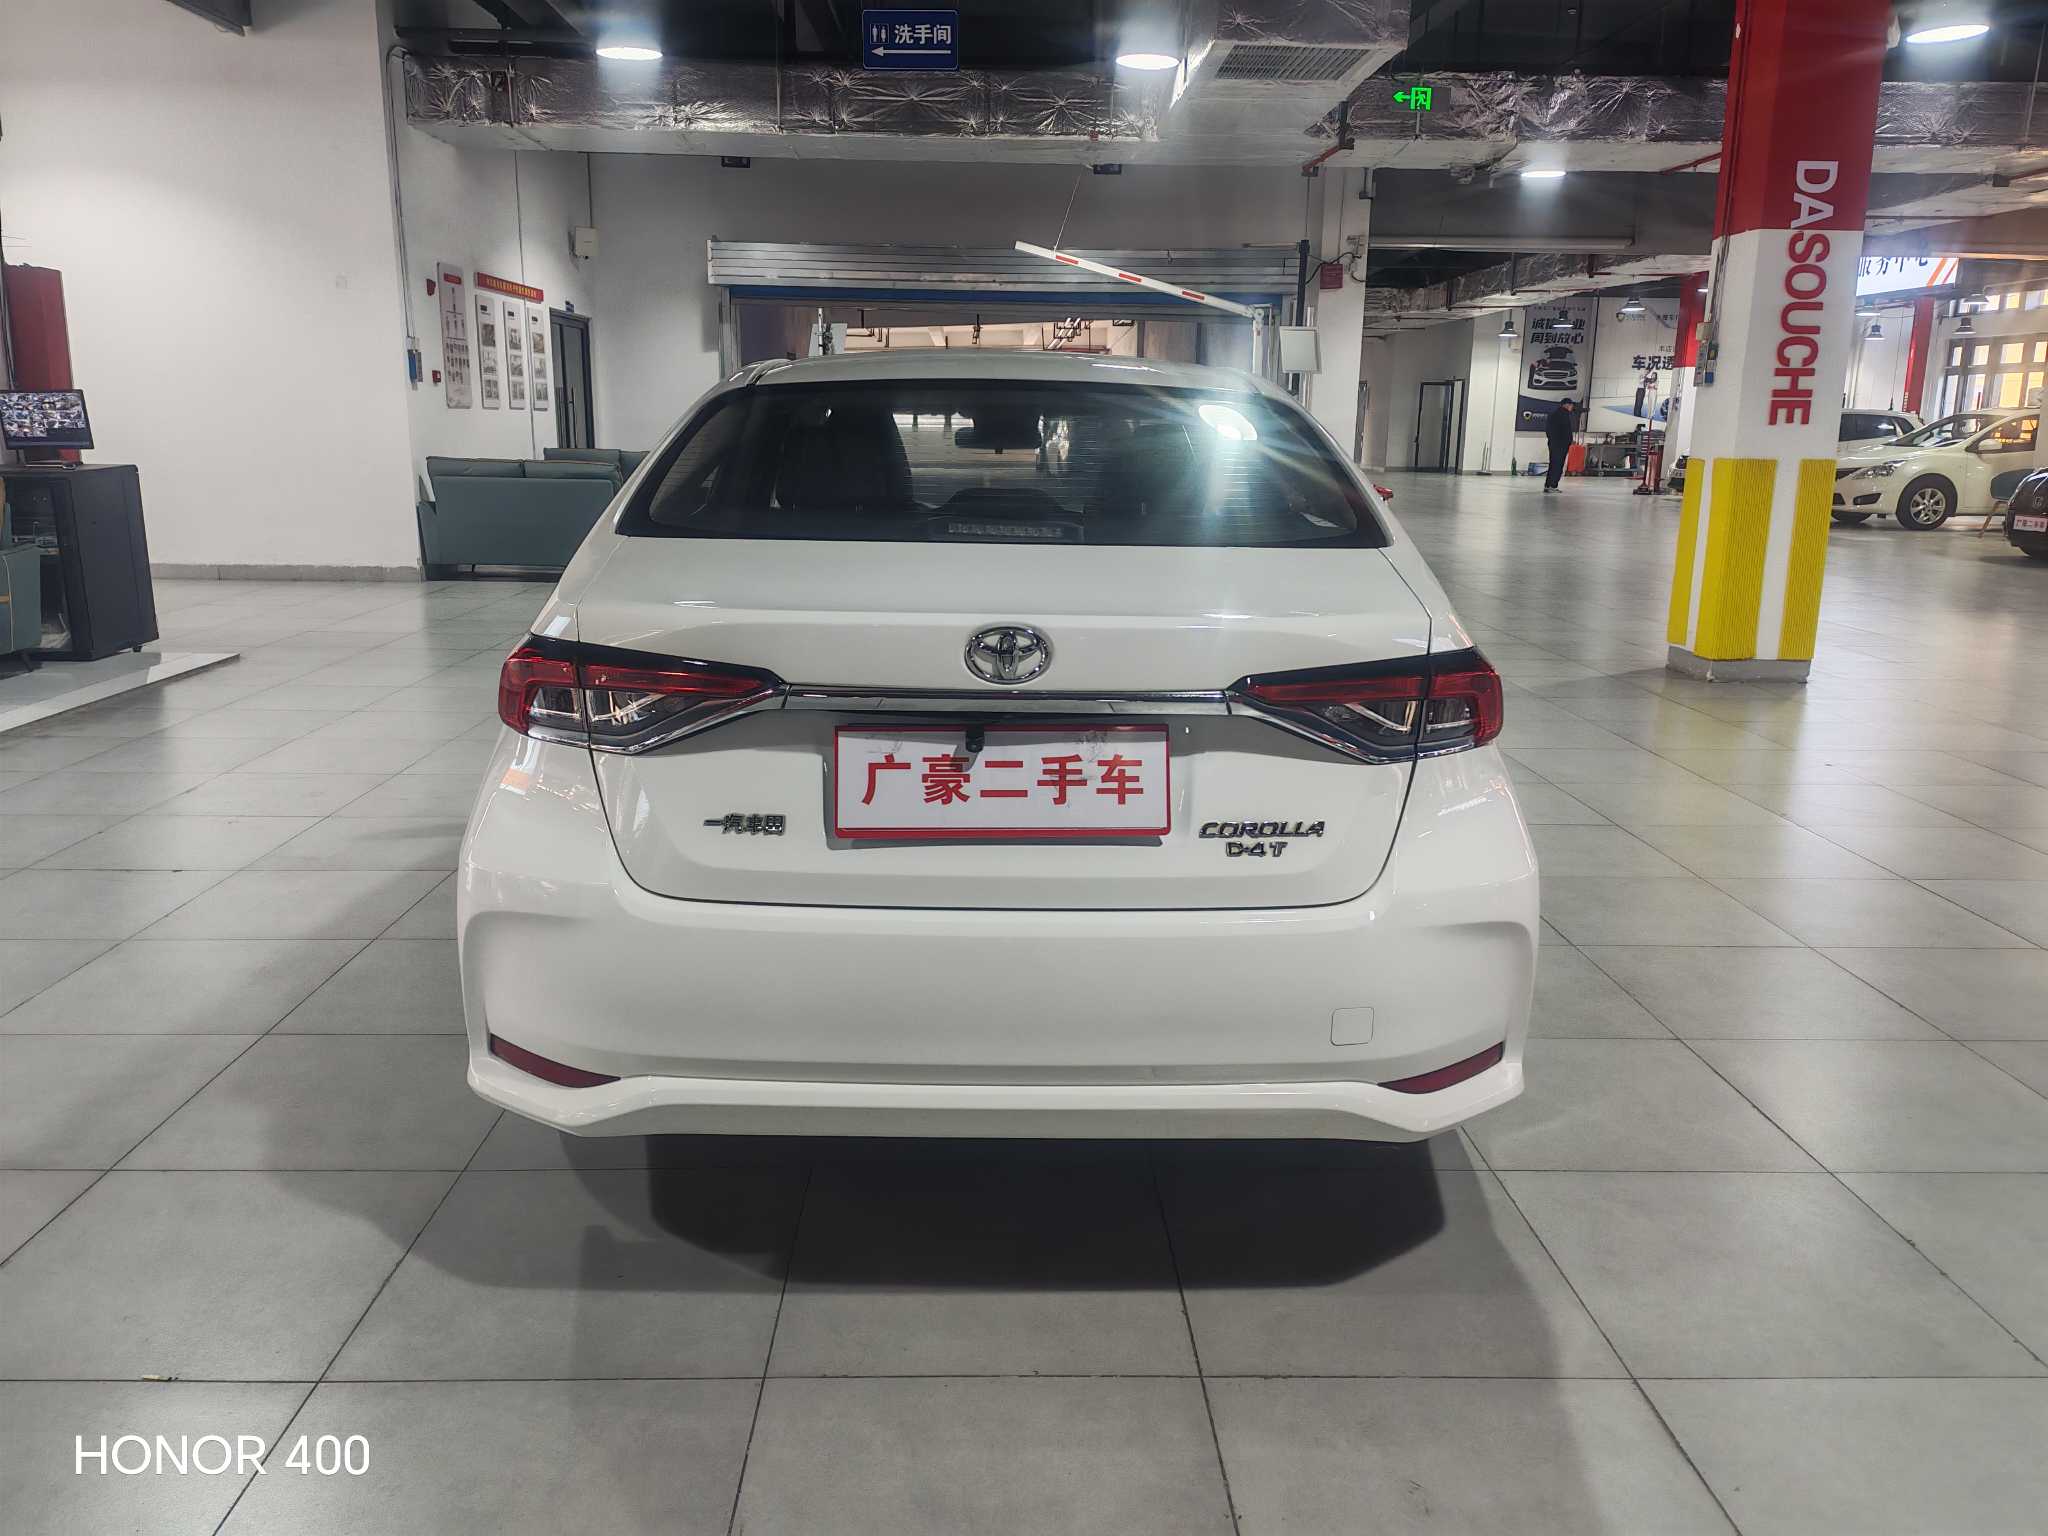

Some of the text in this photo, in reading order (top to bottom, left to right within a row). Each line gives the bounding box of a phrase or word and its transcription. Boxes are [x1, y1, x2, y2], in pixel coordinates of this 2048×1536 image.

[894, 23, 952, 45] 洗手间
[1767, 160, 1839, 426] DASOUCHE
[1531, 318, 1586, 330] 诚信业
[860, 753, 1145, 806] 广豪二手车
[1199, 820, 1326, 839] COROLLA
